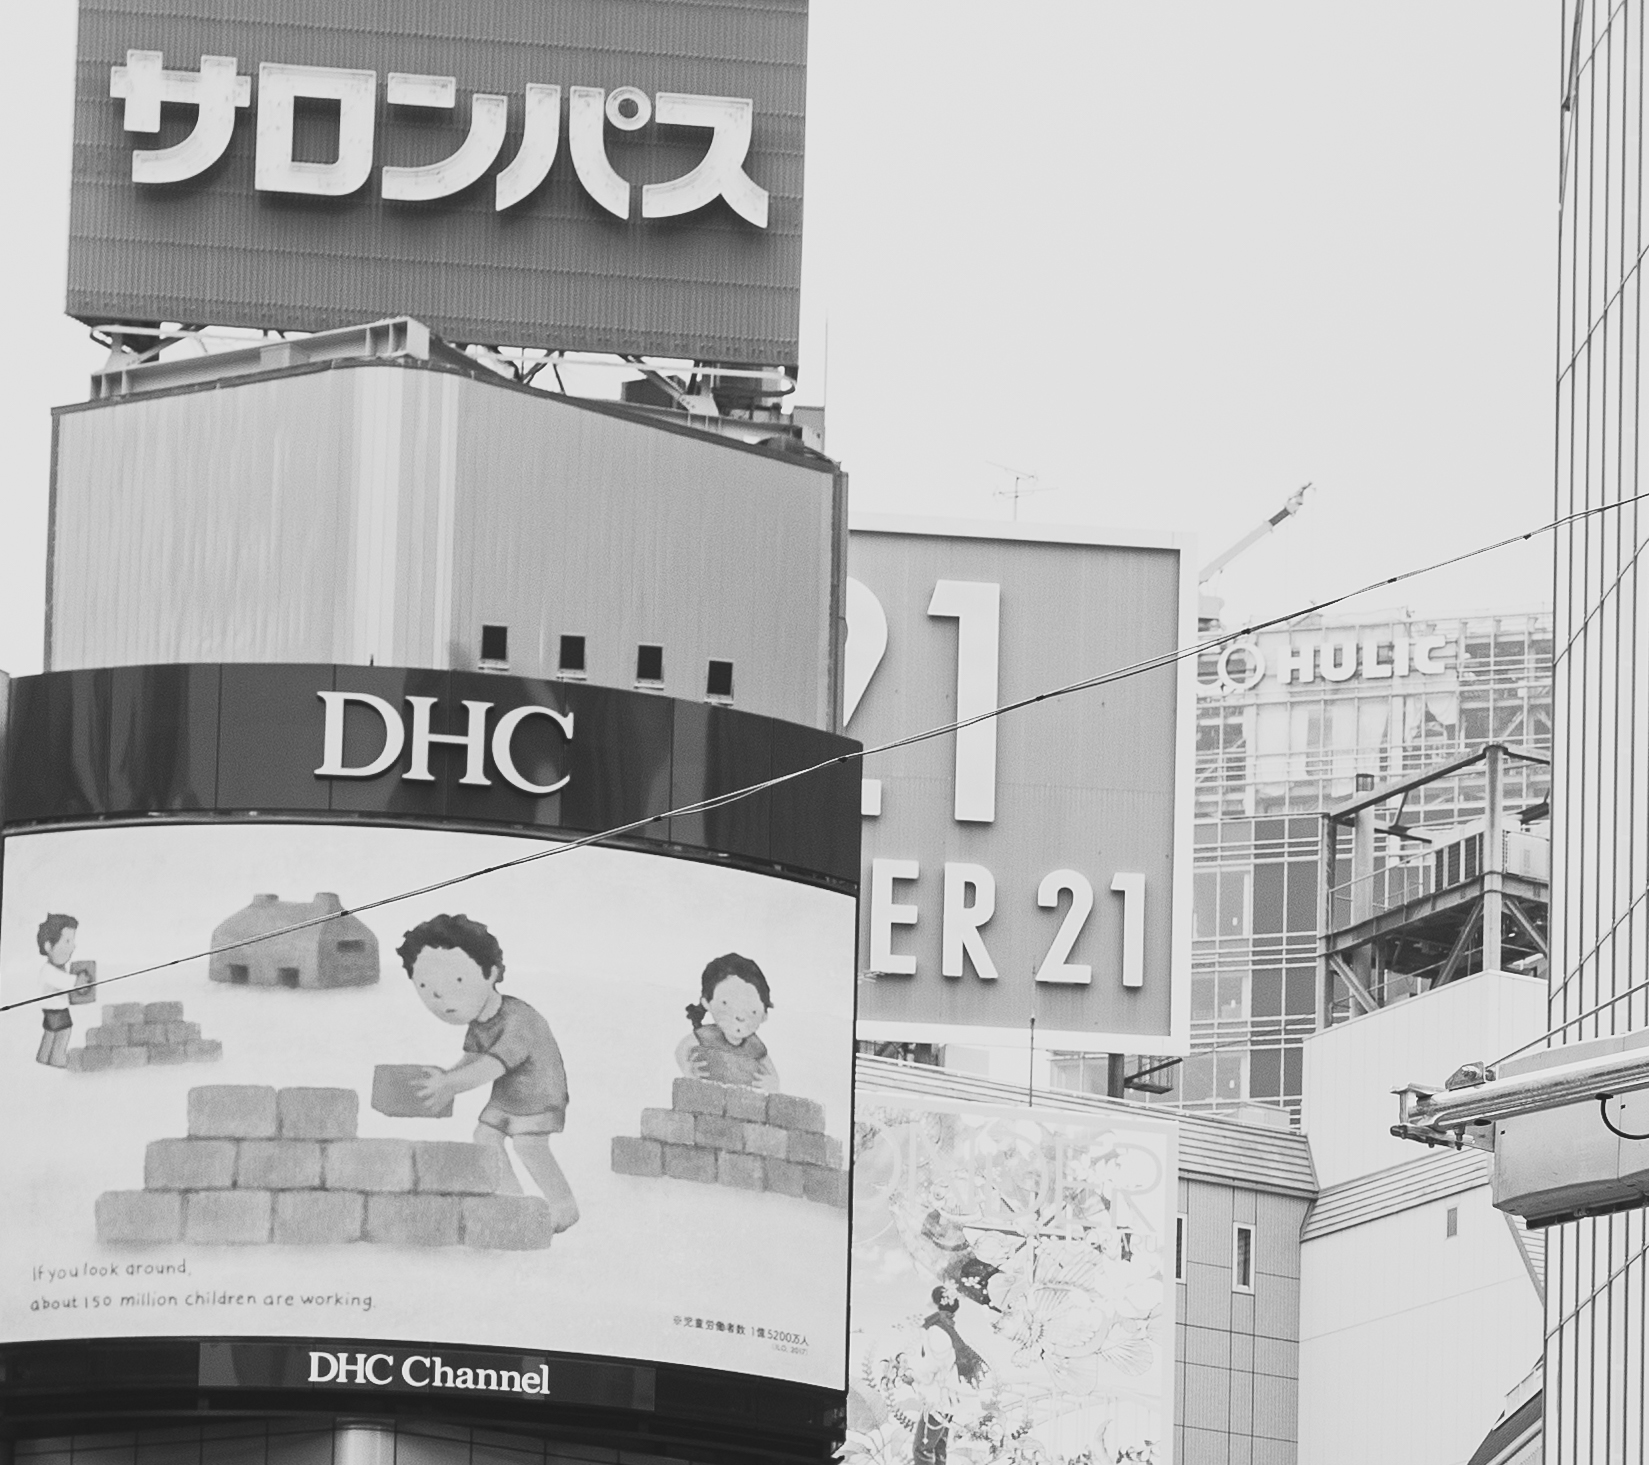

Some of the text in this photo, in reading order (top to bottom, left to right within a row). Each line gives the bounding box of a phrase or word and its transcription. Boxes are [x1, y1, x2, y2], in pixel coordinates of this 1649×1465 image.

[110, 48, 769, 229] サロンパス
[1275, 636, 1448, 685] HULIC
[313, 688, 576, 796] DHC
[1035, 868, 1146, 989] 21
[83, 1261, 119, 1279] look
[30, 1295, 78, 1313] about
[84, 1295, 113, 1310] 150
[120, 1292, 178, 1308] million
[185, 1292, 257, 1307] children
[264, 1294, 295, 1307] are
[307, 1350, 552, 1396] DHC Channel
